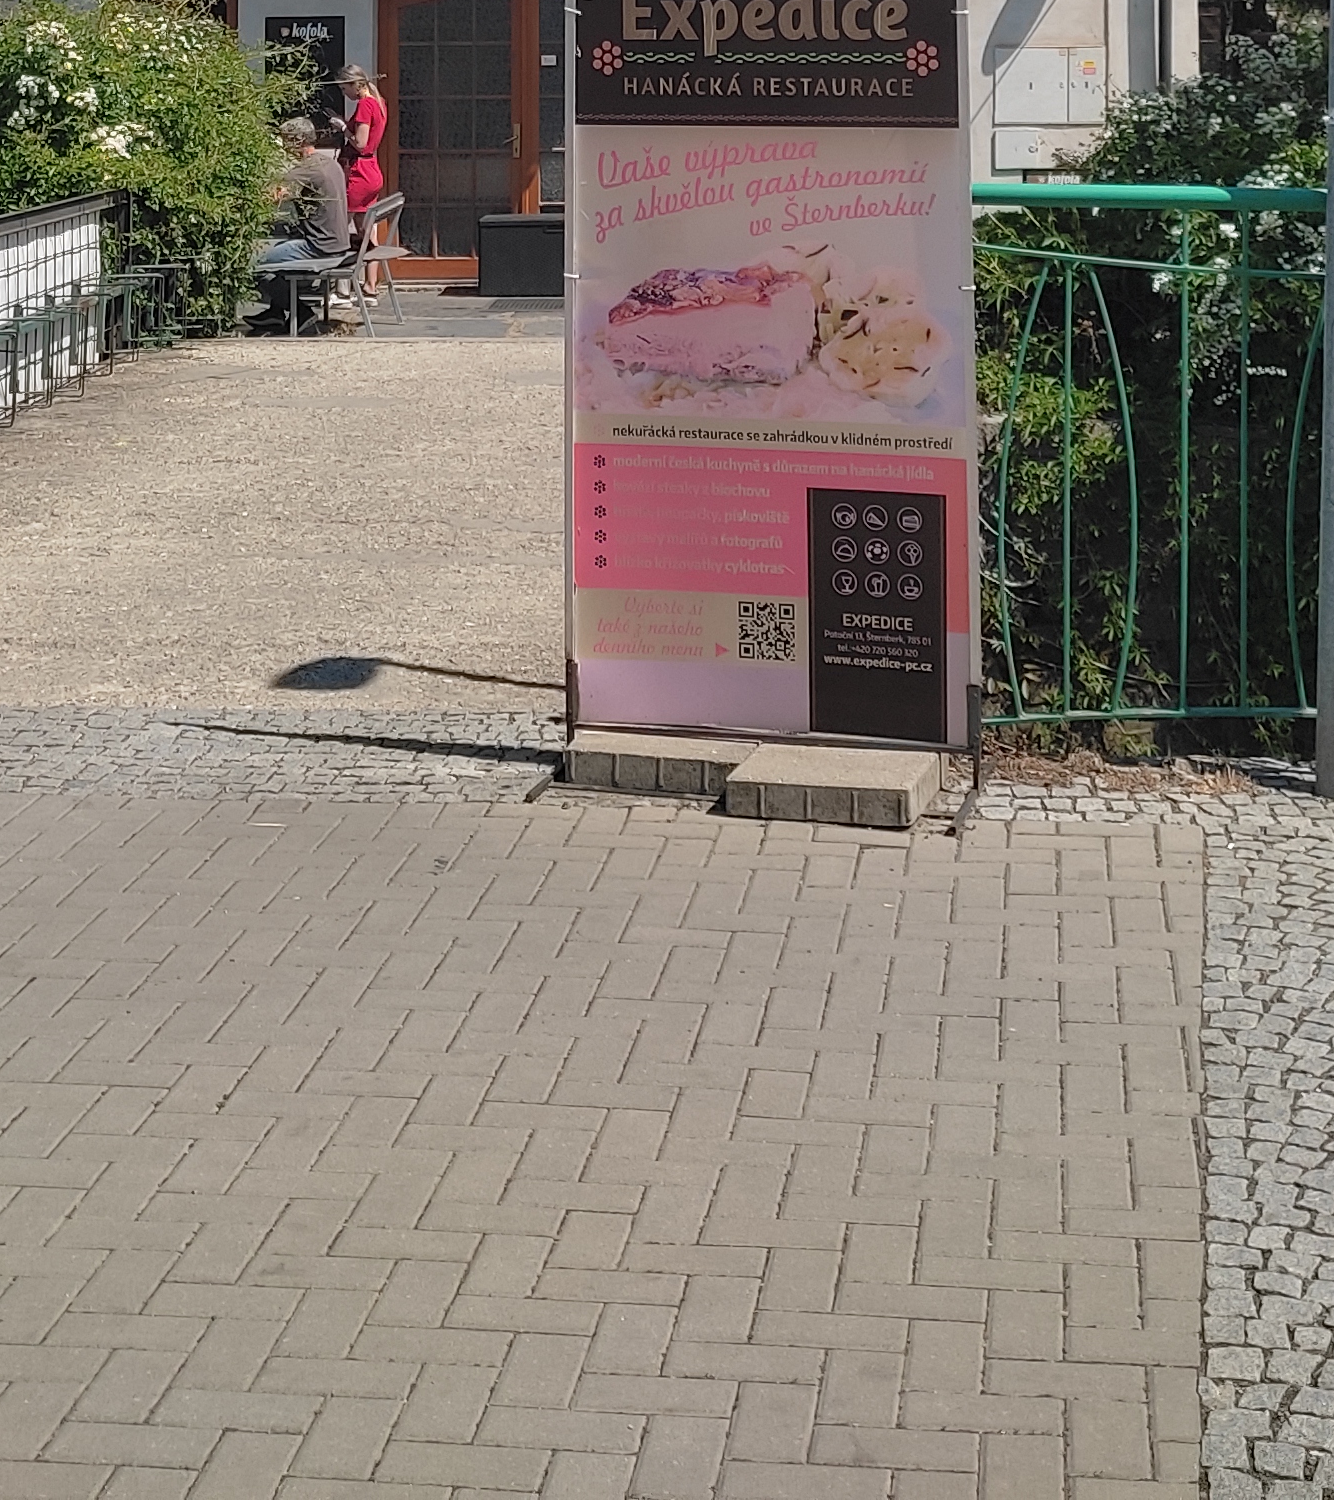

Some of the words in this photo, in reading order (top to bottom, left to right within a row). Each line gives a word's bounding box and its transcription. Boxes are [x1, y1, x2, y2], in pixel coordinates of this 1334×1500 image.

[292, 22, 328, 40] kofola
[623, 72, 742, 97] HANÁCKÁ
[753, 77, 914, 97] RESTAURACE
[597, 146, 671, 189] Vaše
[684, 140, 818, 179] výprava
[595, 203, 624, 244] za
[633, 177, 735, 223] skvělou
[745, 162, 929, 207] gastronomií
[749, 216, 772, 237] ve
[781, 193, 937, 232] Šternberku!
[612, 424, 675, 439] nekuřácká
[678, 428, 744, 441] restaurace
[746, 432, 760, 441] se
[762, 430, 828, 444] zahrádkou
[830, 435, 838, 444] v
[841, 432, 892, 447] klidném
[894, 437, 953, 450] prostředí
[613, 454, 666, 468] moderní
[668, 455, 704, 469] česká
[706, 456, 760, 474] kuchyně
[762, 462, 769, 472] s
[772, 459, 829, 475] důrazem
[905, 464, 934, 482] jídla
[724, 559, 785, 576] cyklotras
[842, 613, 914, 631] EXPEDICE
[922, 637, 932, 646] 01
[823, 655, 933, 672] www.expedice-pc.cz
